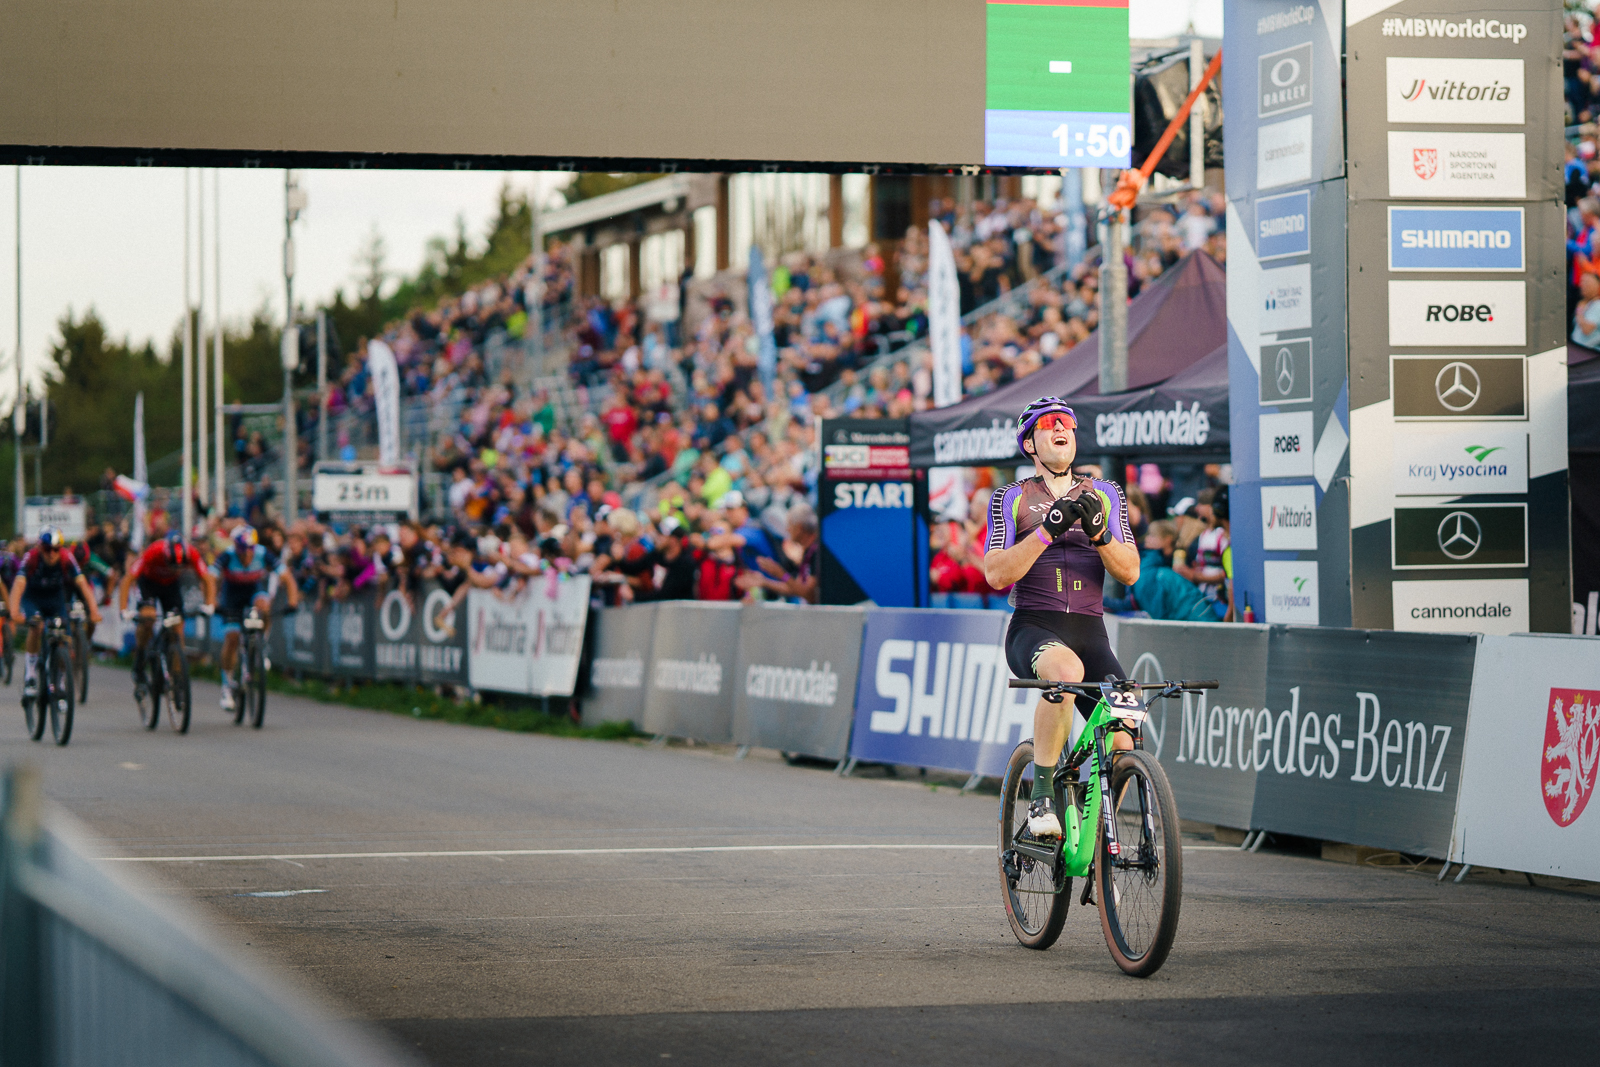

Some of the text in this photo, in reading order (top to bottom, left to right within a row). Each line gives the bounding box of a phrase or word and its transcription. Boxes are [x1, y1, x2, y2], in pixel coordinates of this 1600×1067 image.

[1382, 18, 1528, 44] #MBWorldCup
[1428, 80, 1511, 101] vittoria
[1052, 123, 1131, 158] 1:50
[1450, 172, 1495, 180] AGENTURA
[1260, 213, 1305, 238] SHIMANO
[1401, 230, 1511, 249] SHIMANO
[1095, 400, 1210, 447] cannondale
[1409, 464, 1437, 480] Kraj
[338, 483, 389, 500] 25m
[834, 482, 914, 509] START
[1276, 504, 1312, 528] vittoria
[1411, 603, 1511, 619] cannondale
[746, 661, 838, 706] cannondale
[1109, 692, 1139, 707] 23
[1176, 686, 1452, 793] Mercedes-Benz
